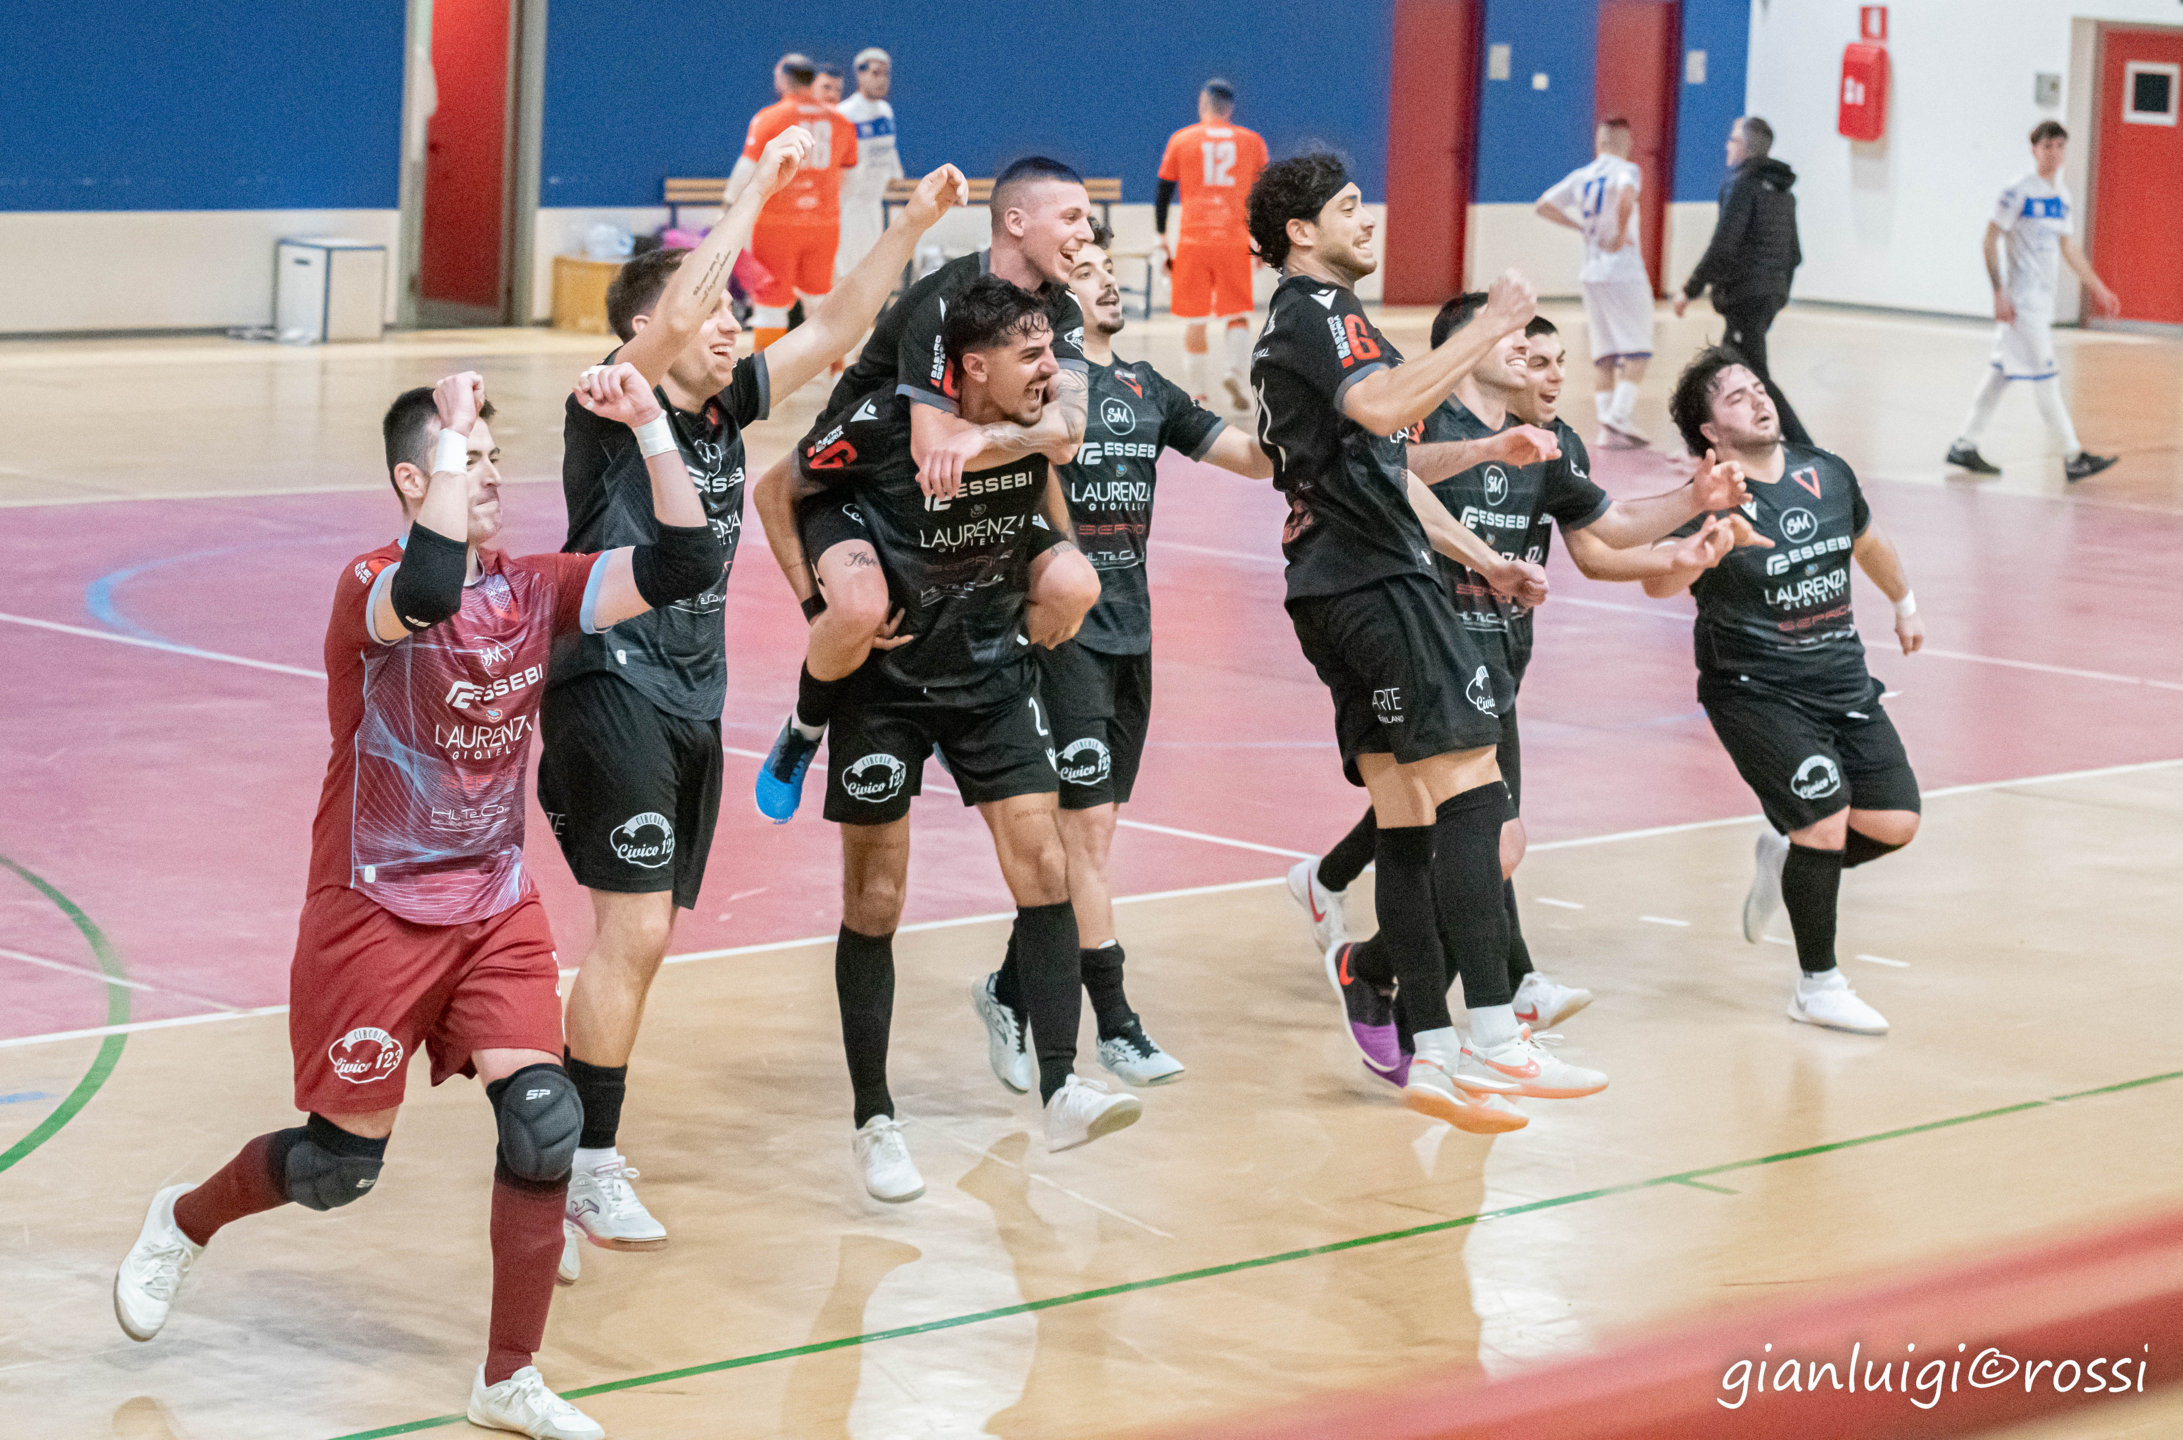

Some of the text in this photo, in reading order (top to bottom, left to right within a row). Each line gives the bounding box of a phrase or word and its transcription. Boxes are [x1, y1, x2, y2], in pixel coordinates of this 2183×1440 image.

[1202, 141, 1237, 187] 12
[1106, 407, 1130, 424] SM
[1104, 441, 1157, 458] ESSEB
[955, 471, 1033, 499] ESSEBI
[1478, 509, 1530, 530] ESSEBI
[1786, 513, 1812, 536] SM
[1788, 535, 1852, 564] ESSEBI
[1764, 567, 1848, 606] LAURENZA
[473, 663, 543, 702] ESSEBI
[1060, 764, 1096, 780] Civico
[847, 781, 886, 796] Civico
[616, 842, 660, 859] Civico
[374, 1047, 403, 1070] 123
[525, 1088, 551, 1101] SP
